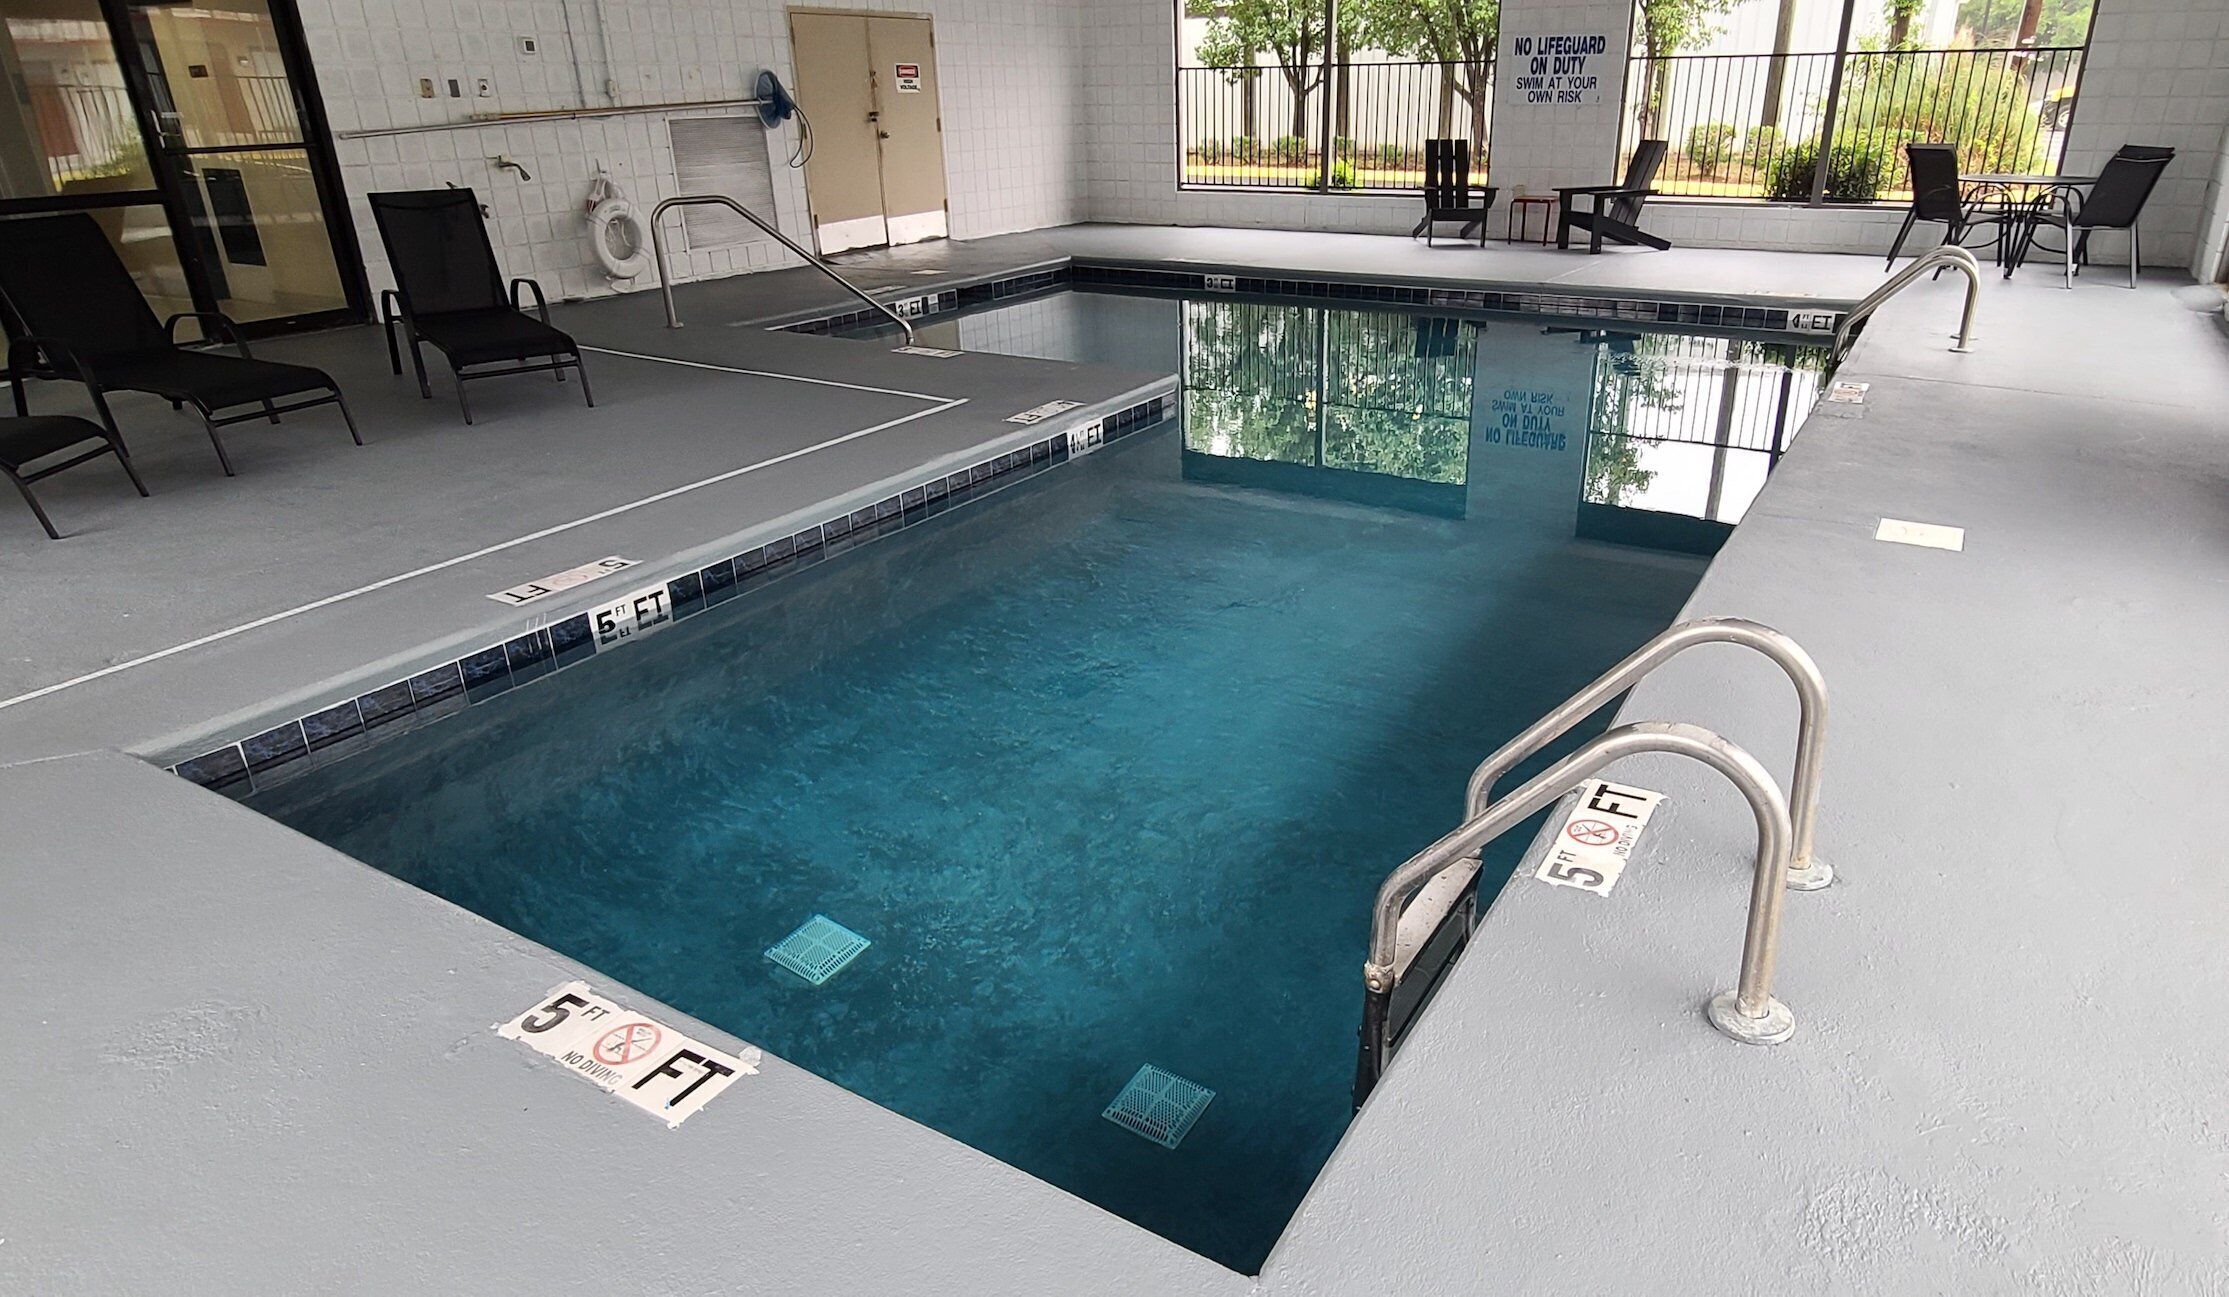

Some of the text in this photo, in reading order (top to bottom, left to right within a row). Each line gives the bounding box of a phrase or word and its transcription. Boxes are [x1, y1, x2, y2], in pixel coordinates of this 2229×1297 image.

[1514, 35, 1606, 56] NO LIFEGUARD
[1530, 56, 1586, 75] ON DUTY
[1516, 76, 1597, 90] SWIM AT YOUR
[1527, 90, 1581, 103] OWN RISK
[505, 584, 552, 603] FT
[596, 590, 664, 636] 5 FT FT
[1587, 784, 1647, 819] FT
[1547, 850, 1604, 887] 5 FT
[521, 993, 735, 1107] 5 FT FT
[561, 1050, 623, 1085] NO DIVING
